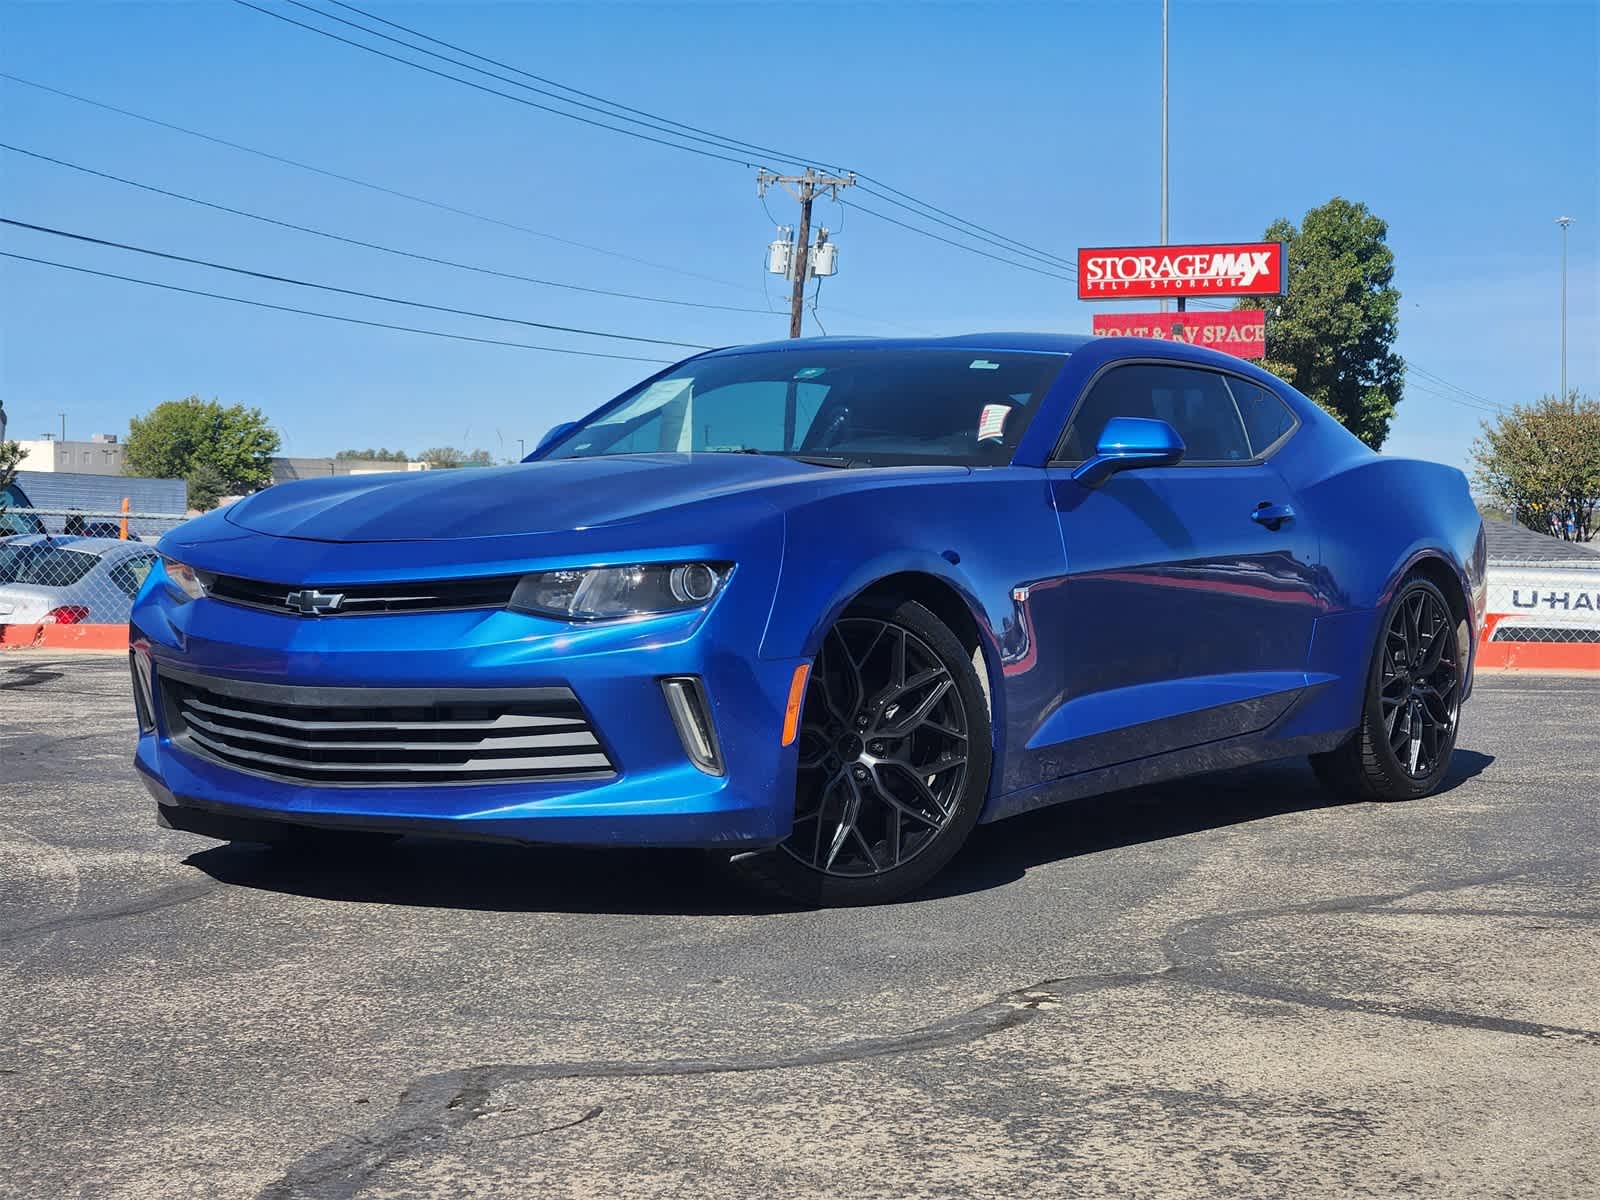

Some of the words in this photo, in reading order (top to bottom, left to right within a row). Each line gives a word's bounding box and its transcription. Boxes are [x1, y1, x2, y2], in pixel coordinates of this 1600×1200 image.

[1086, 251, 1272, 286] STORAGEMAX
[1087, 280, 1130, 290] SELF
[1150, 278, 1236, 289] STORAGE
[1203, 324, 1265, 343] SPACE
[1512, 590, 1600, 611] U-HA
